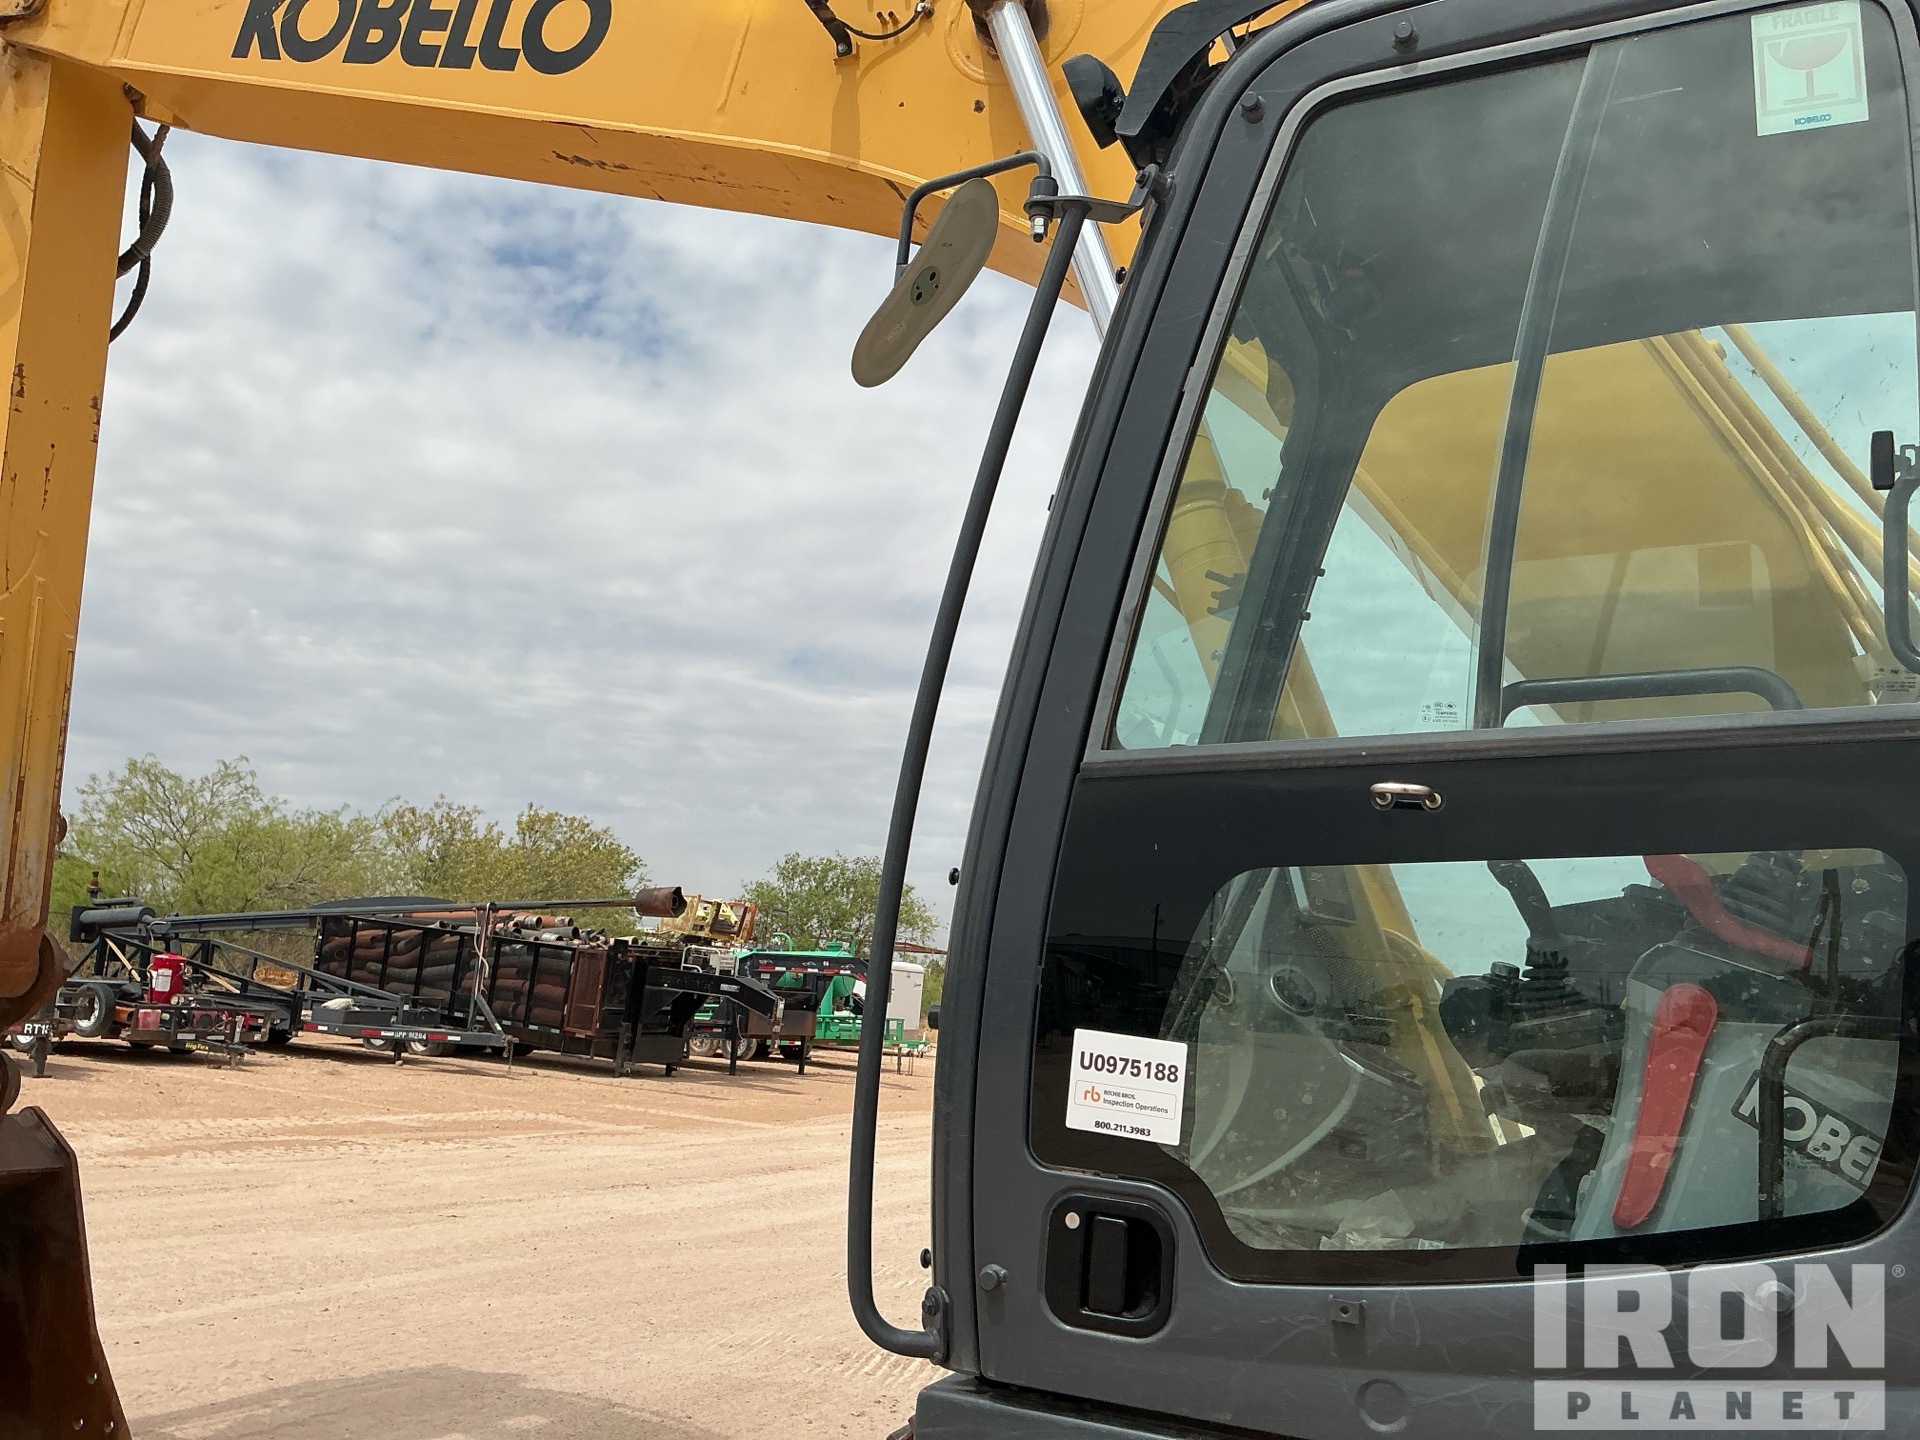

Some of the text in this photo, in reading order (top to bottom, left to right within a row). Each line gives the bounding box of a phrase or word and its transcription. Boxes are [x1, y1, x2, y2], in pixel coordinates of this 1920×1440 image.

[1772, 5, 1839, 30] FRAGILE
[1794, 113, 1832, 126] KOBELCO
[1079, 1051, 1179, 1083] U0975188
[1083, 1085, 1101, 1103] rb
[1103, 1089, 1121, 1098] RITCHIE
[1103, 1098, 1169, 1114] Inspection Operations
[1094, 1120, 1151, 1137] 800.211.3983
